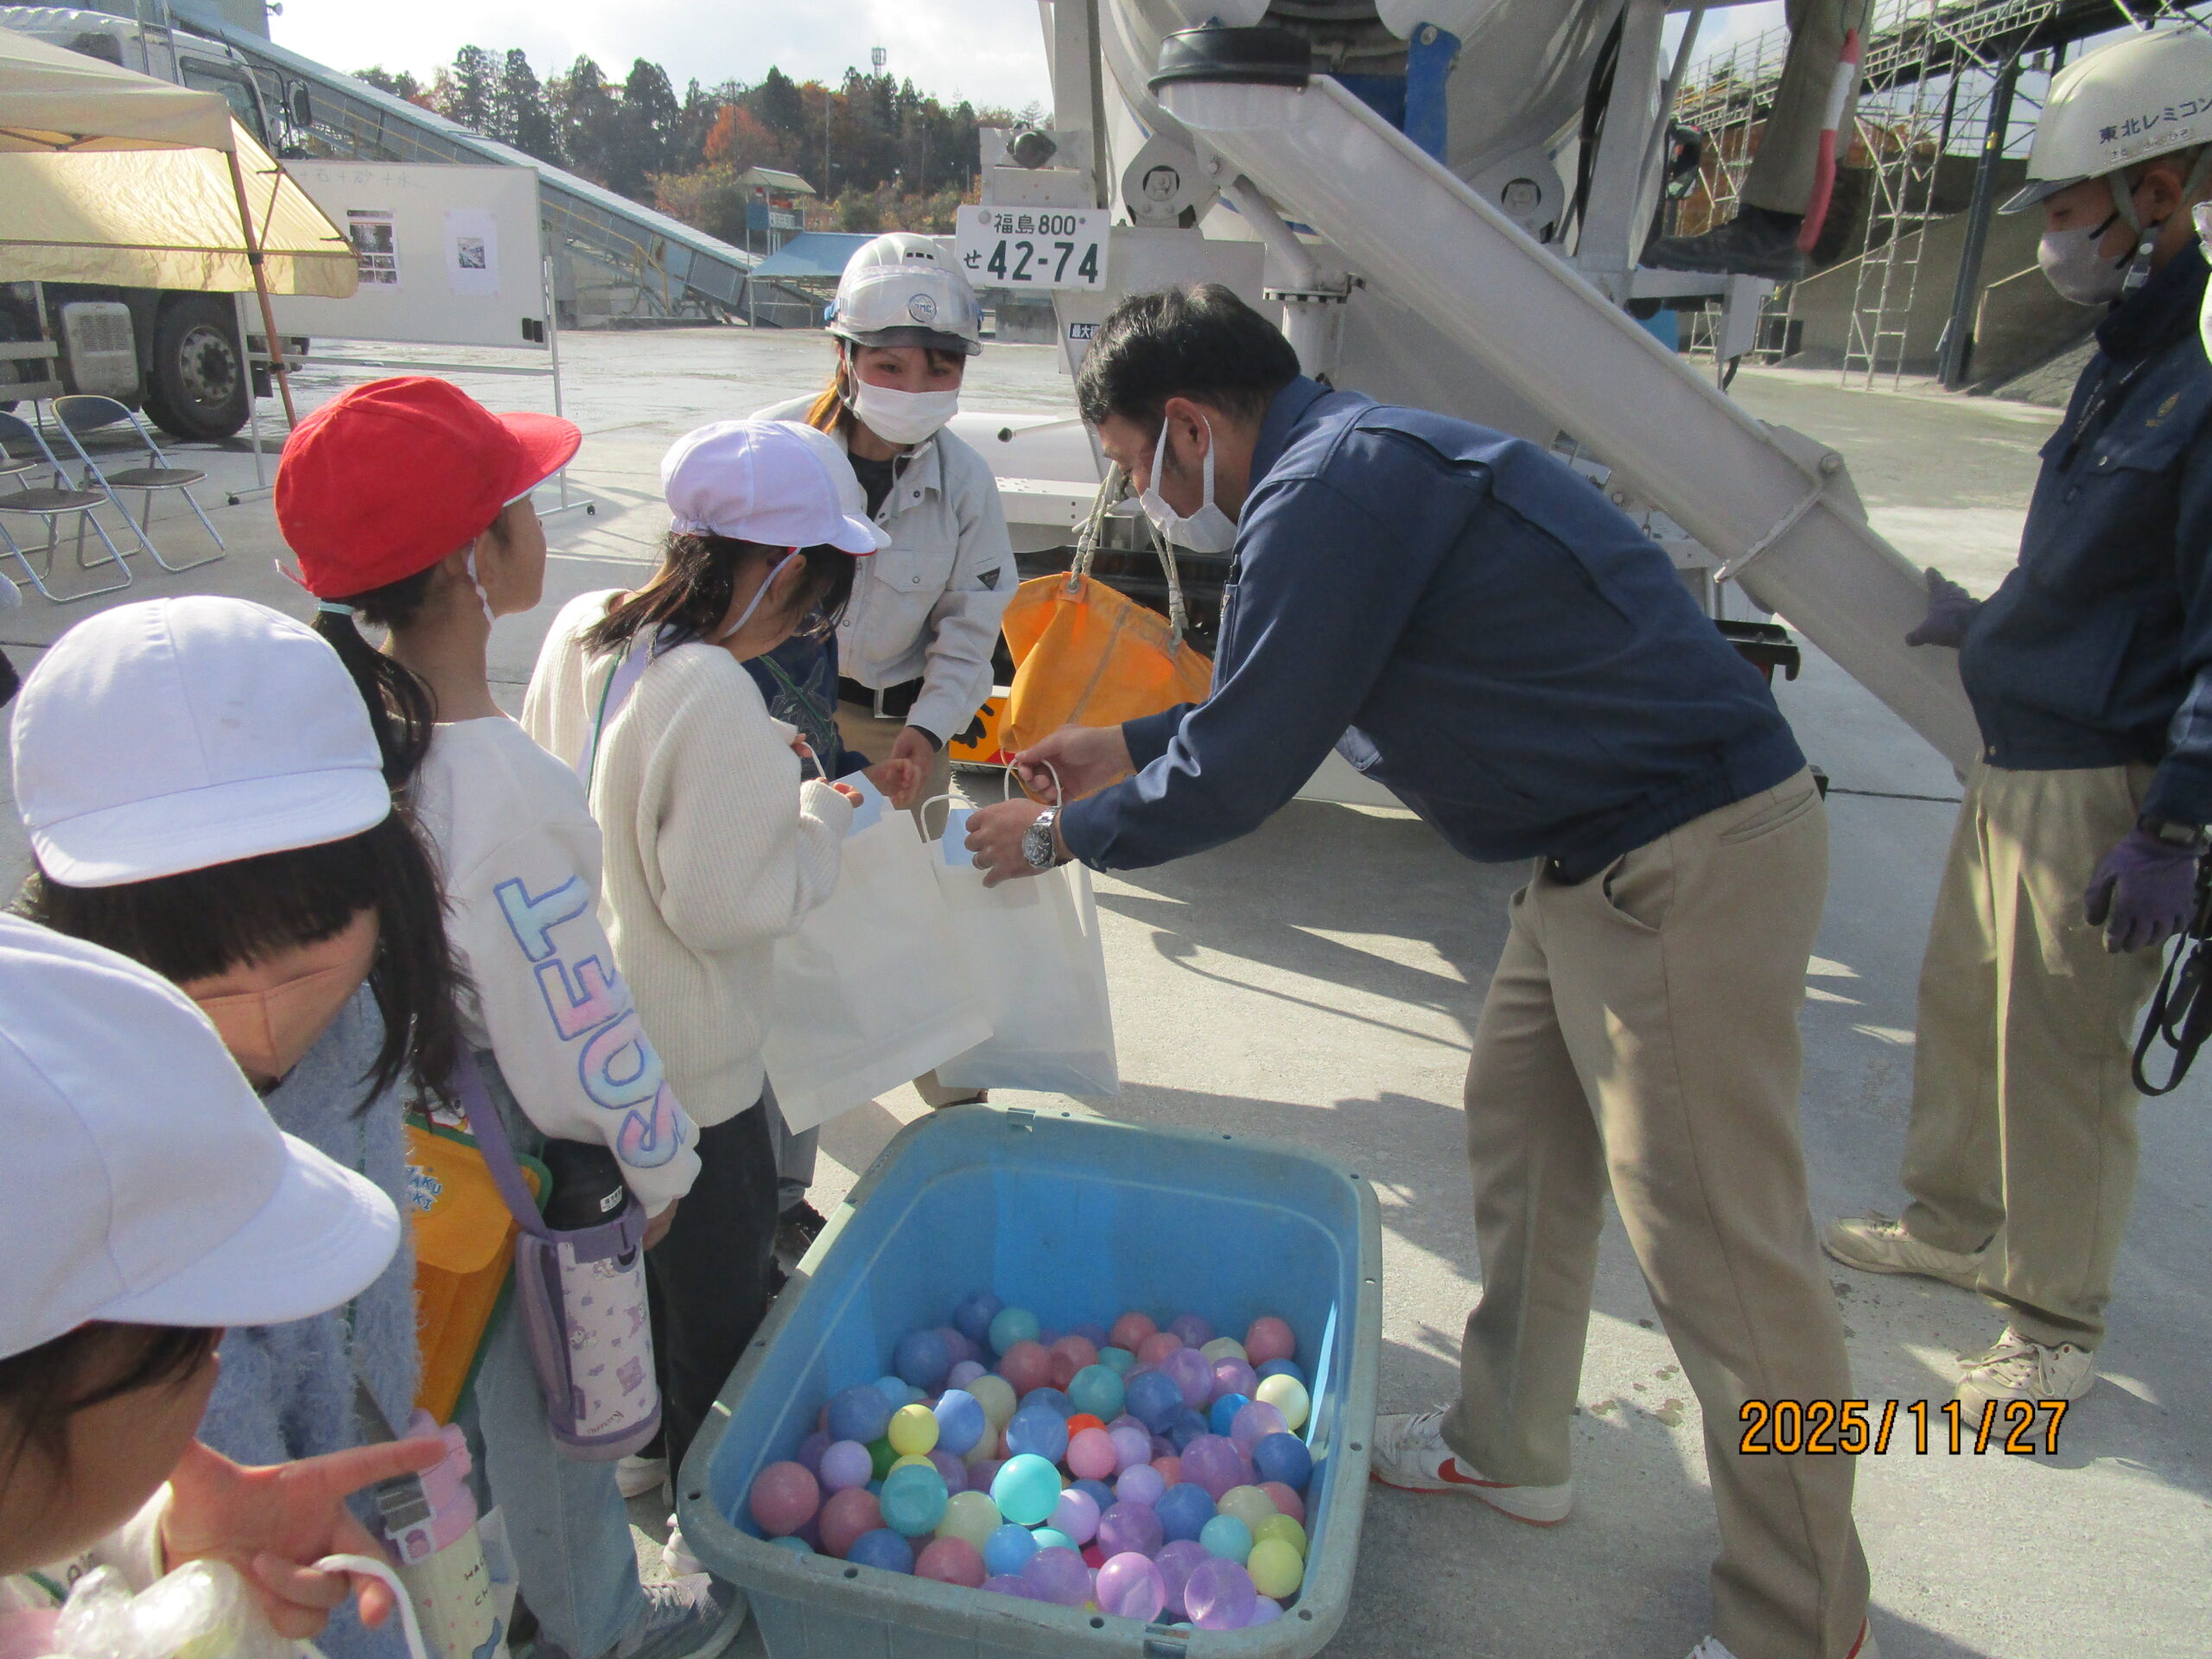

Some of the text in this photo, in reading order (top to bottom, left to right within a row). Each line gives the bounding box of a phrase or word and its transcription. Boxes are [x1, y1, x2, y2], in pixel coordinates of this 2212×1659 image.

[2099, 98, 2212, 144] 東北レミコン
[994, 213, 1077, 235] 福島 800
[963, 239, 1098, 283] せ 42-74
[493, 874, 689, 1168] SOFT
